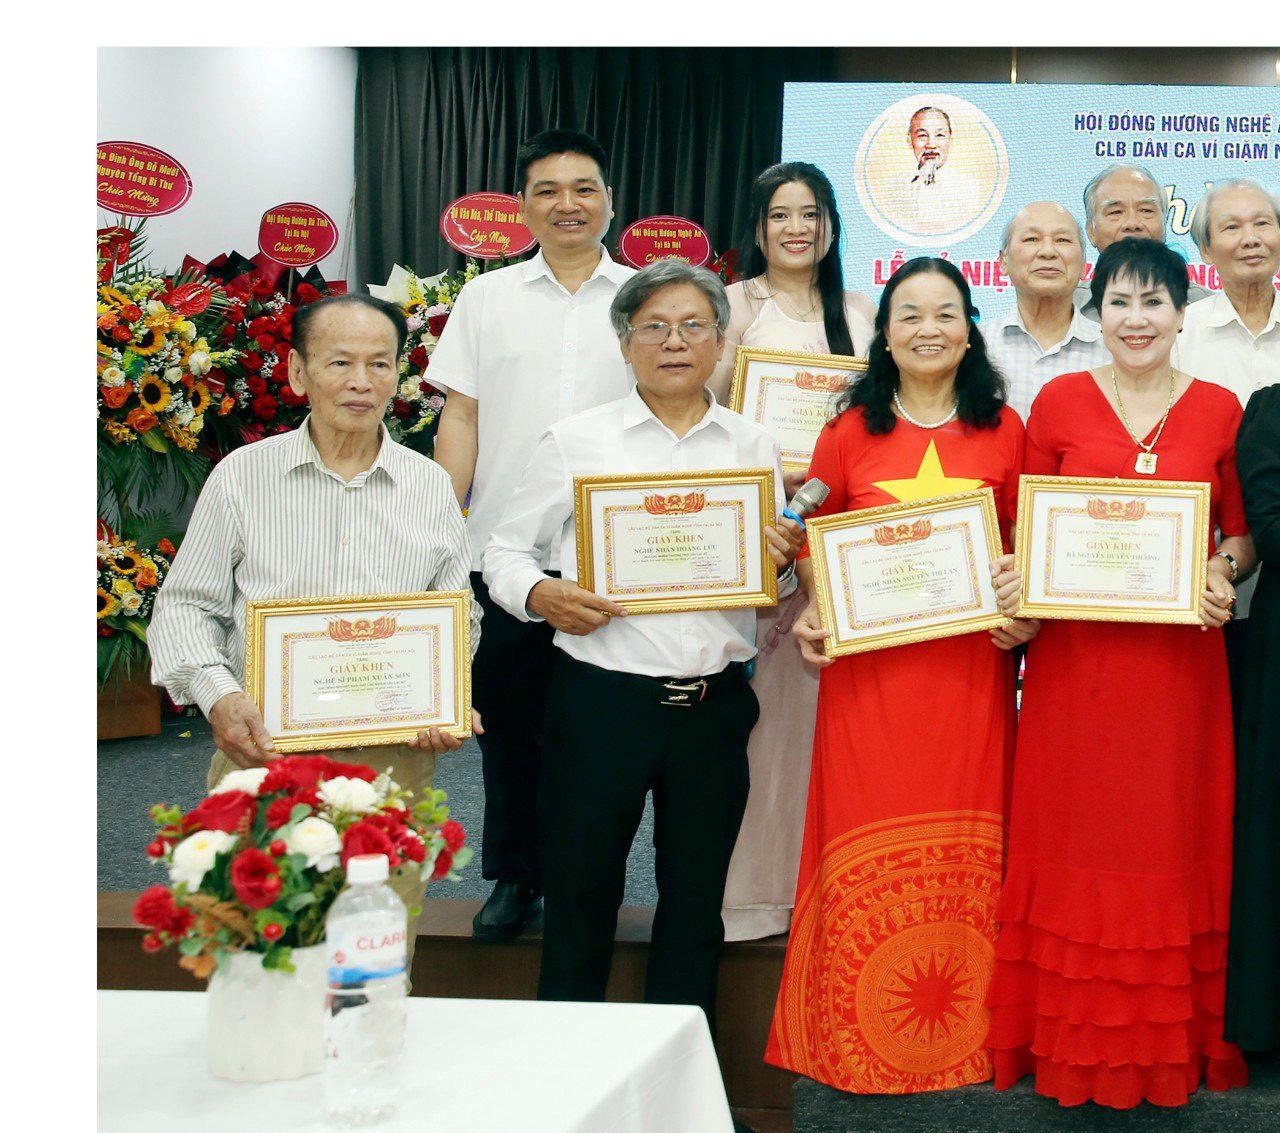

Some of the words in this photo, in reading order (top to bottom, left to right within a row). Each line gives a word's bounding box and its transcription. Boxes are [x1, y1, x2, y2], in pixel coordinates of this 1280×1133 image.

[1074, 111, 1103, 134] HỘI
[1108, 109, 1155, 132] ĐỒNG
[1161, 114, 1220, 133] HƯƠNG
[1226, 113, 1271, 137] NGHỆ
[1095, 141, 1127, 157] CLB
[1132, 138, 1168, 158] DÂN
[1174, 142, 1196, 158] CA
[1201, 139, 1218, 158] VÍ
[1223, 140, 1268, 162] GIẶM
[962, 259, 1010, 292] NIỆ
